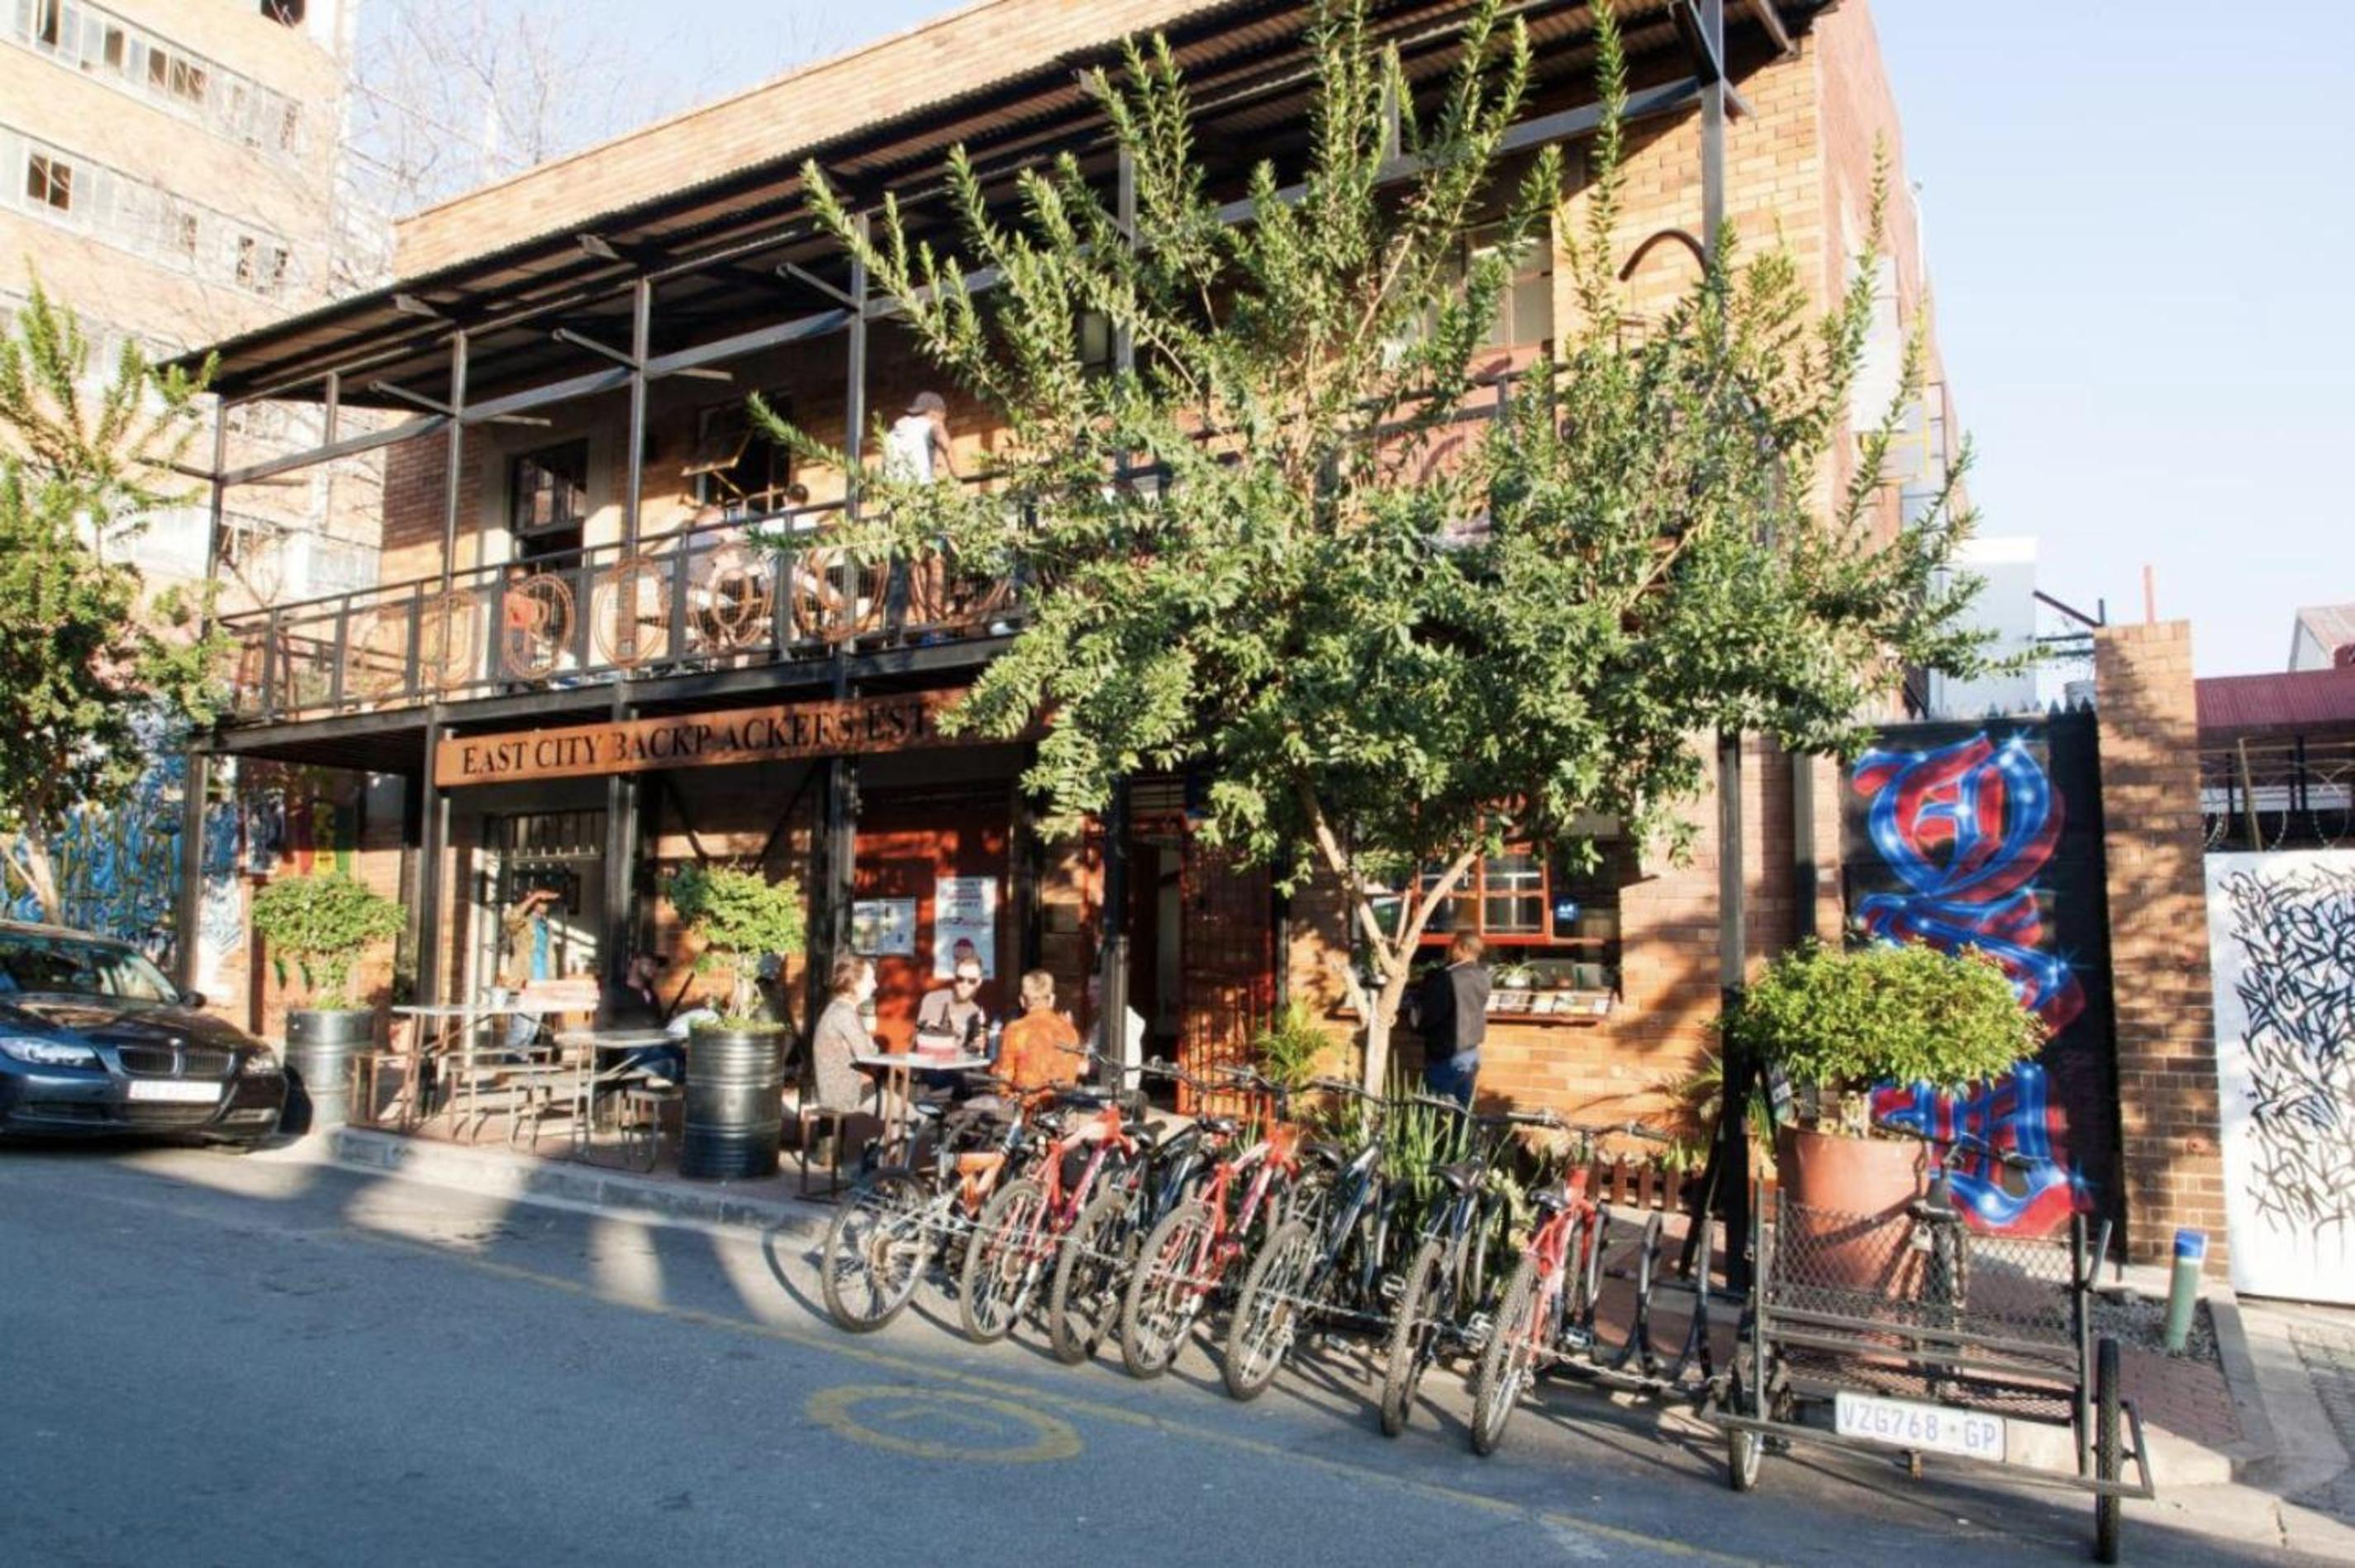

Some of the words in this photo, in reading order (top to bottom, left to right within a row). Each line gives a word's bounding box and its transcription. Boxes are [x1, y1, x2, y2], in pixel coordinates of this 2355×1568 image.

[463, 743, 528, 775] EAST
[535, 734, 602, 767] CITY
[1843, 1402, 1939, 1442] VZG768
[1964, 1419, 1997, 1449] GP
